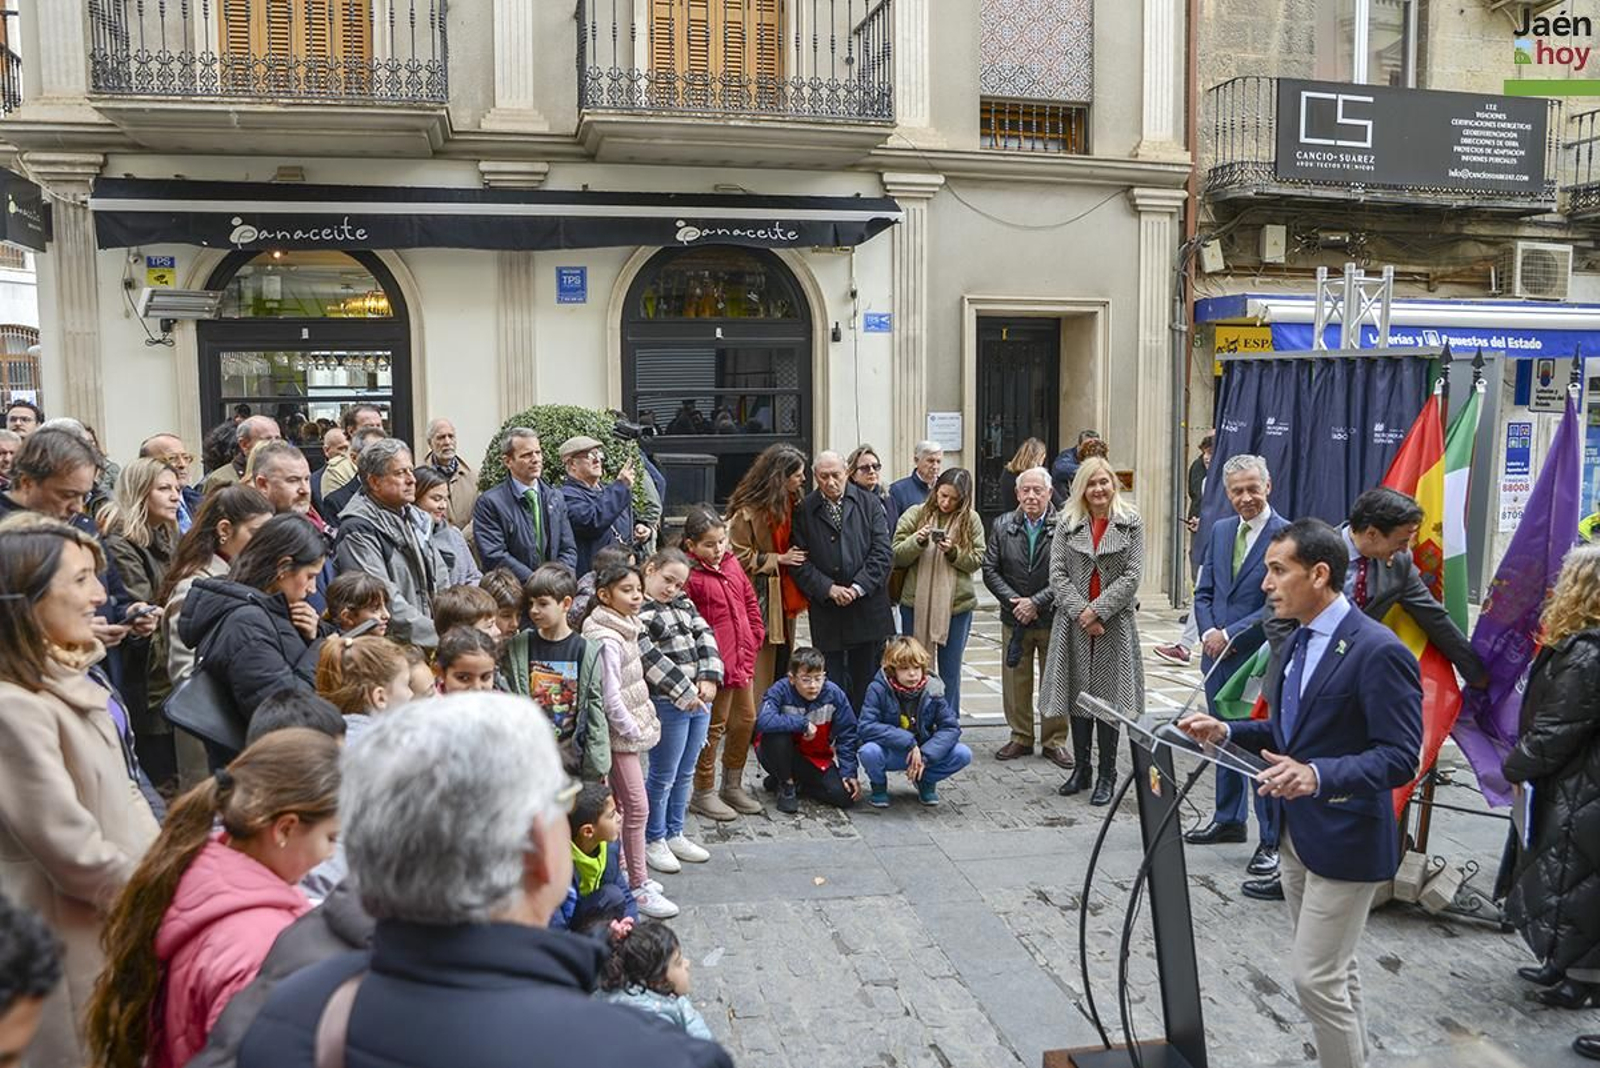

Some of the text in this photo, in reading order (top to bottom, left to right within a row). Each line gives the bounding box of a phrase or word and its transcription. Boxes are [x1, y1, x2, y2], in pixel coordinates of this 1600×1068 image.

[1299, 90, 1374, 148] CS
[1453, 145, 1484, 154] PROYECTOS
[1484, 147, 1493, 155] DE
[1461, 154, 1488, 163] INFORMES
[1296, 160, 1341, 169] ARQUTECTOS
[150, 255, 171, 266] TPS
[562, 275, 582, 285] TPS
[1193, 333, 1203, 348] 5
[1368, 332, 1415, 346] Lerías
[1415, 335, 1424, 347] y
[1490, 336, 1506, 348] del
[1507, 336, 1543, 350] Estado
[1502, 483, 1530, 492] 88008
